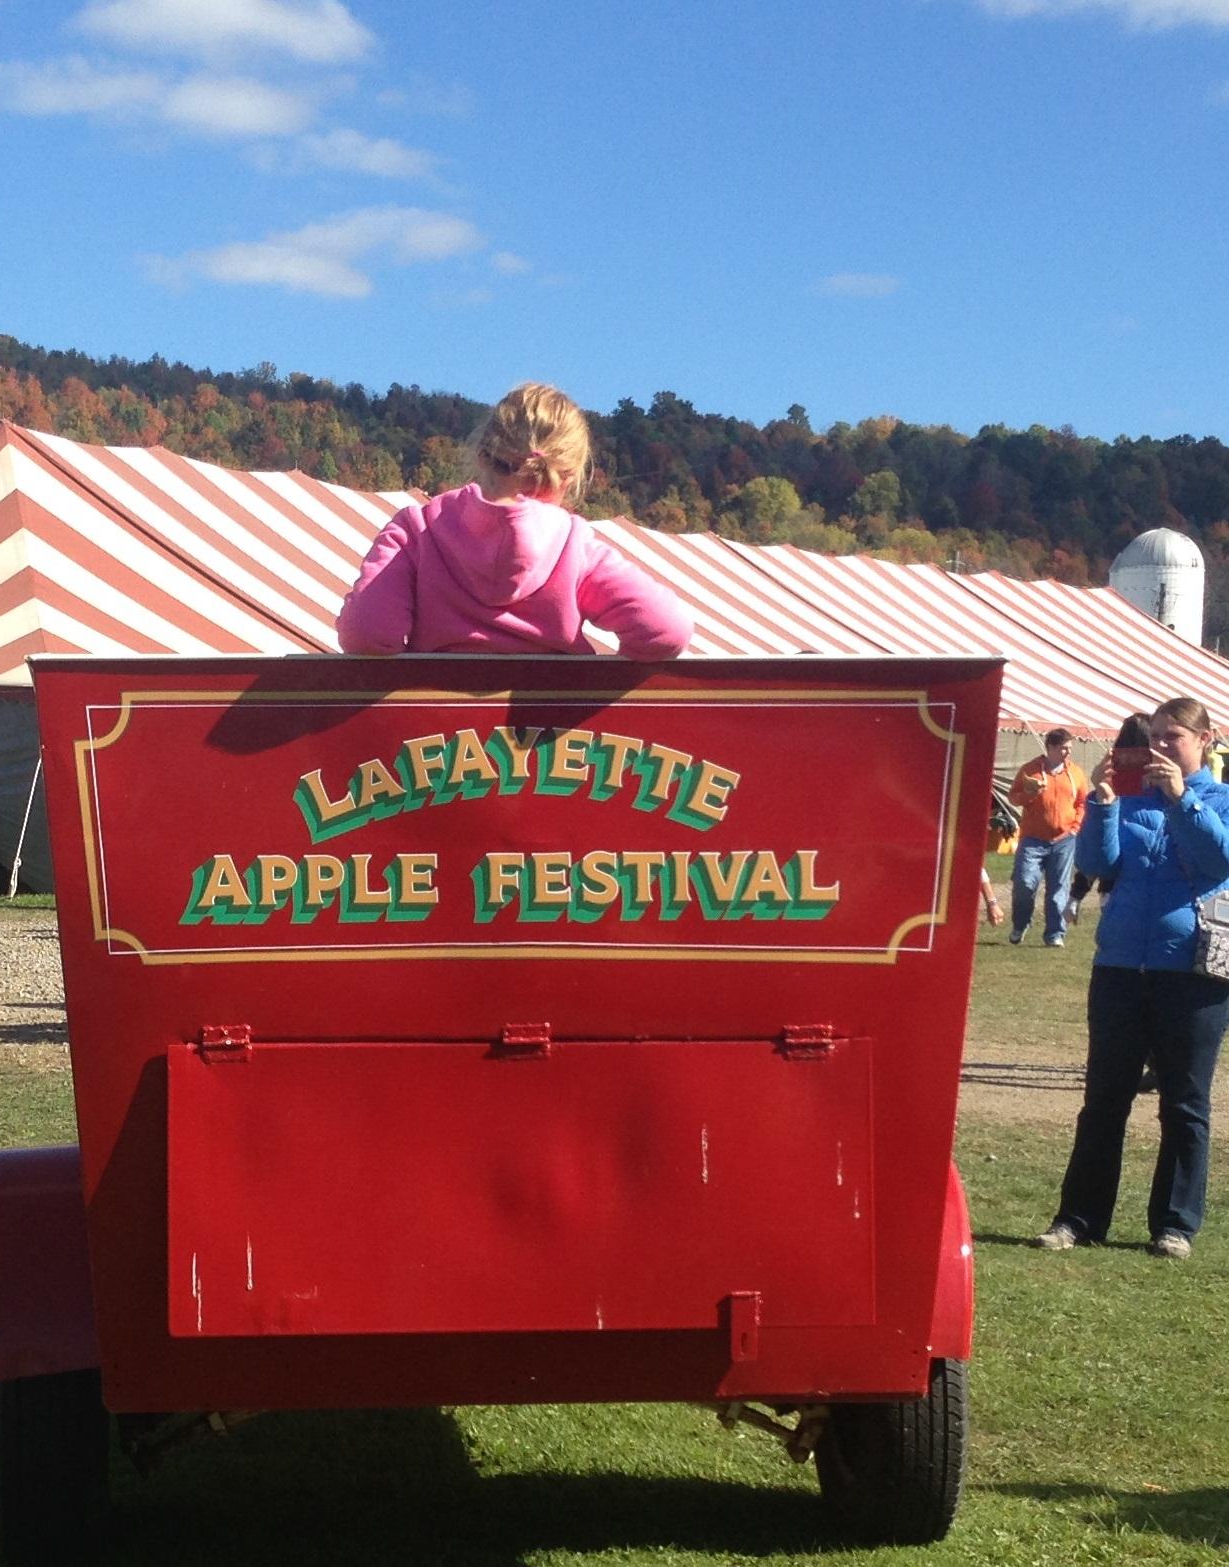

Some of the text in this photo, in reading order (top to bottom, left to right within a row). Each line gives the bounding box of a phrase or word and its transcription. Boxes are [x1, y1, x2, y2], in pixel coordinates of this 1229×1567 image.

[293, 726, 740, 845] LAFAYETTE
[178, 850, 841, 924] APPLE FESTIVAL
